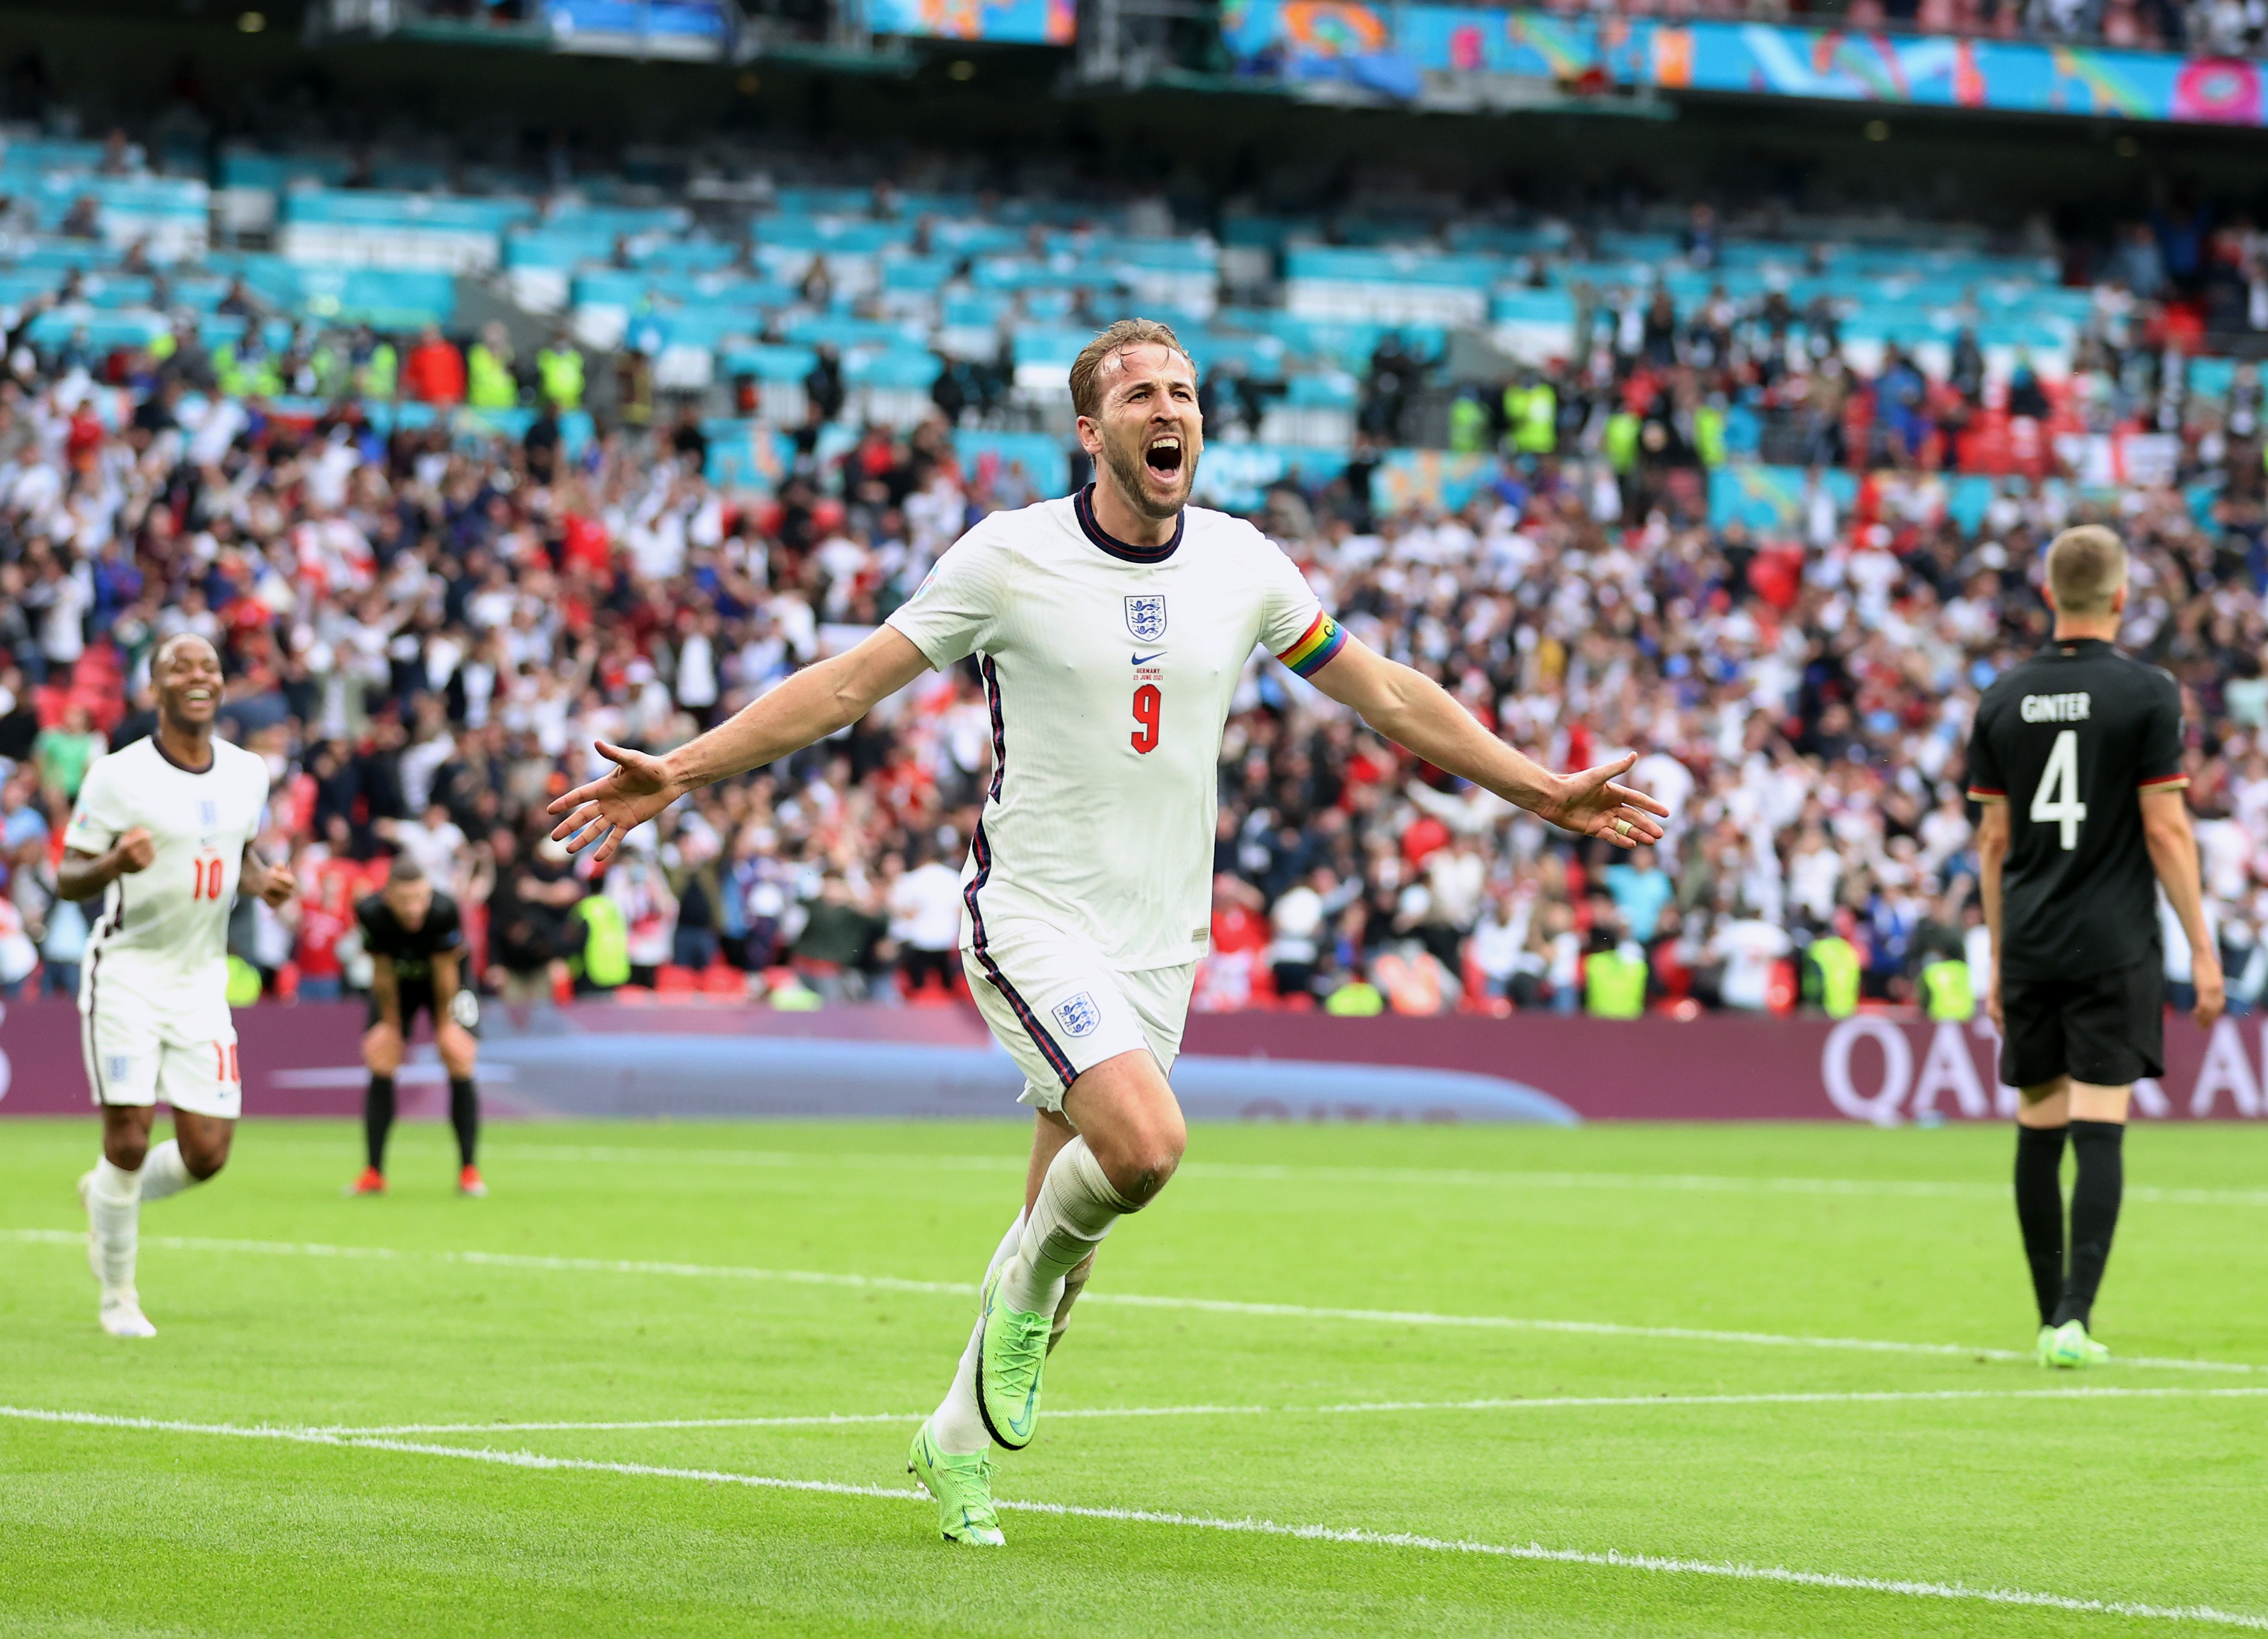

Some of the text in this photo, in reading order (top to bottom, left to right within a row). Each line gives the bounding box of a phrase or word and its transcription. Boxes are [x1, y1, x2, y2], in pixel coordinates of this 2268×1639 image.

[1131, 684, 1161, 754] 9
[2020, 692, 2091, 723] GINTER
[2030, 729, 2087, 851] 4
[193, 858, 222, 900] 10
